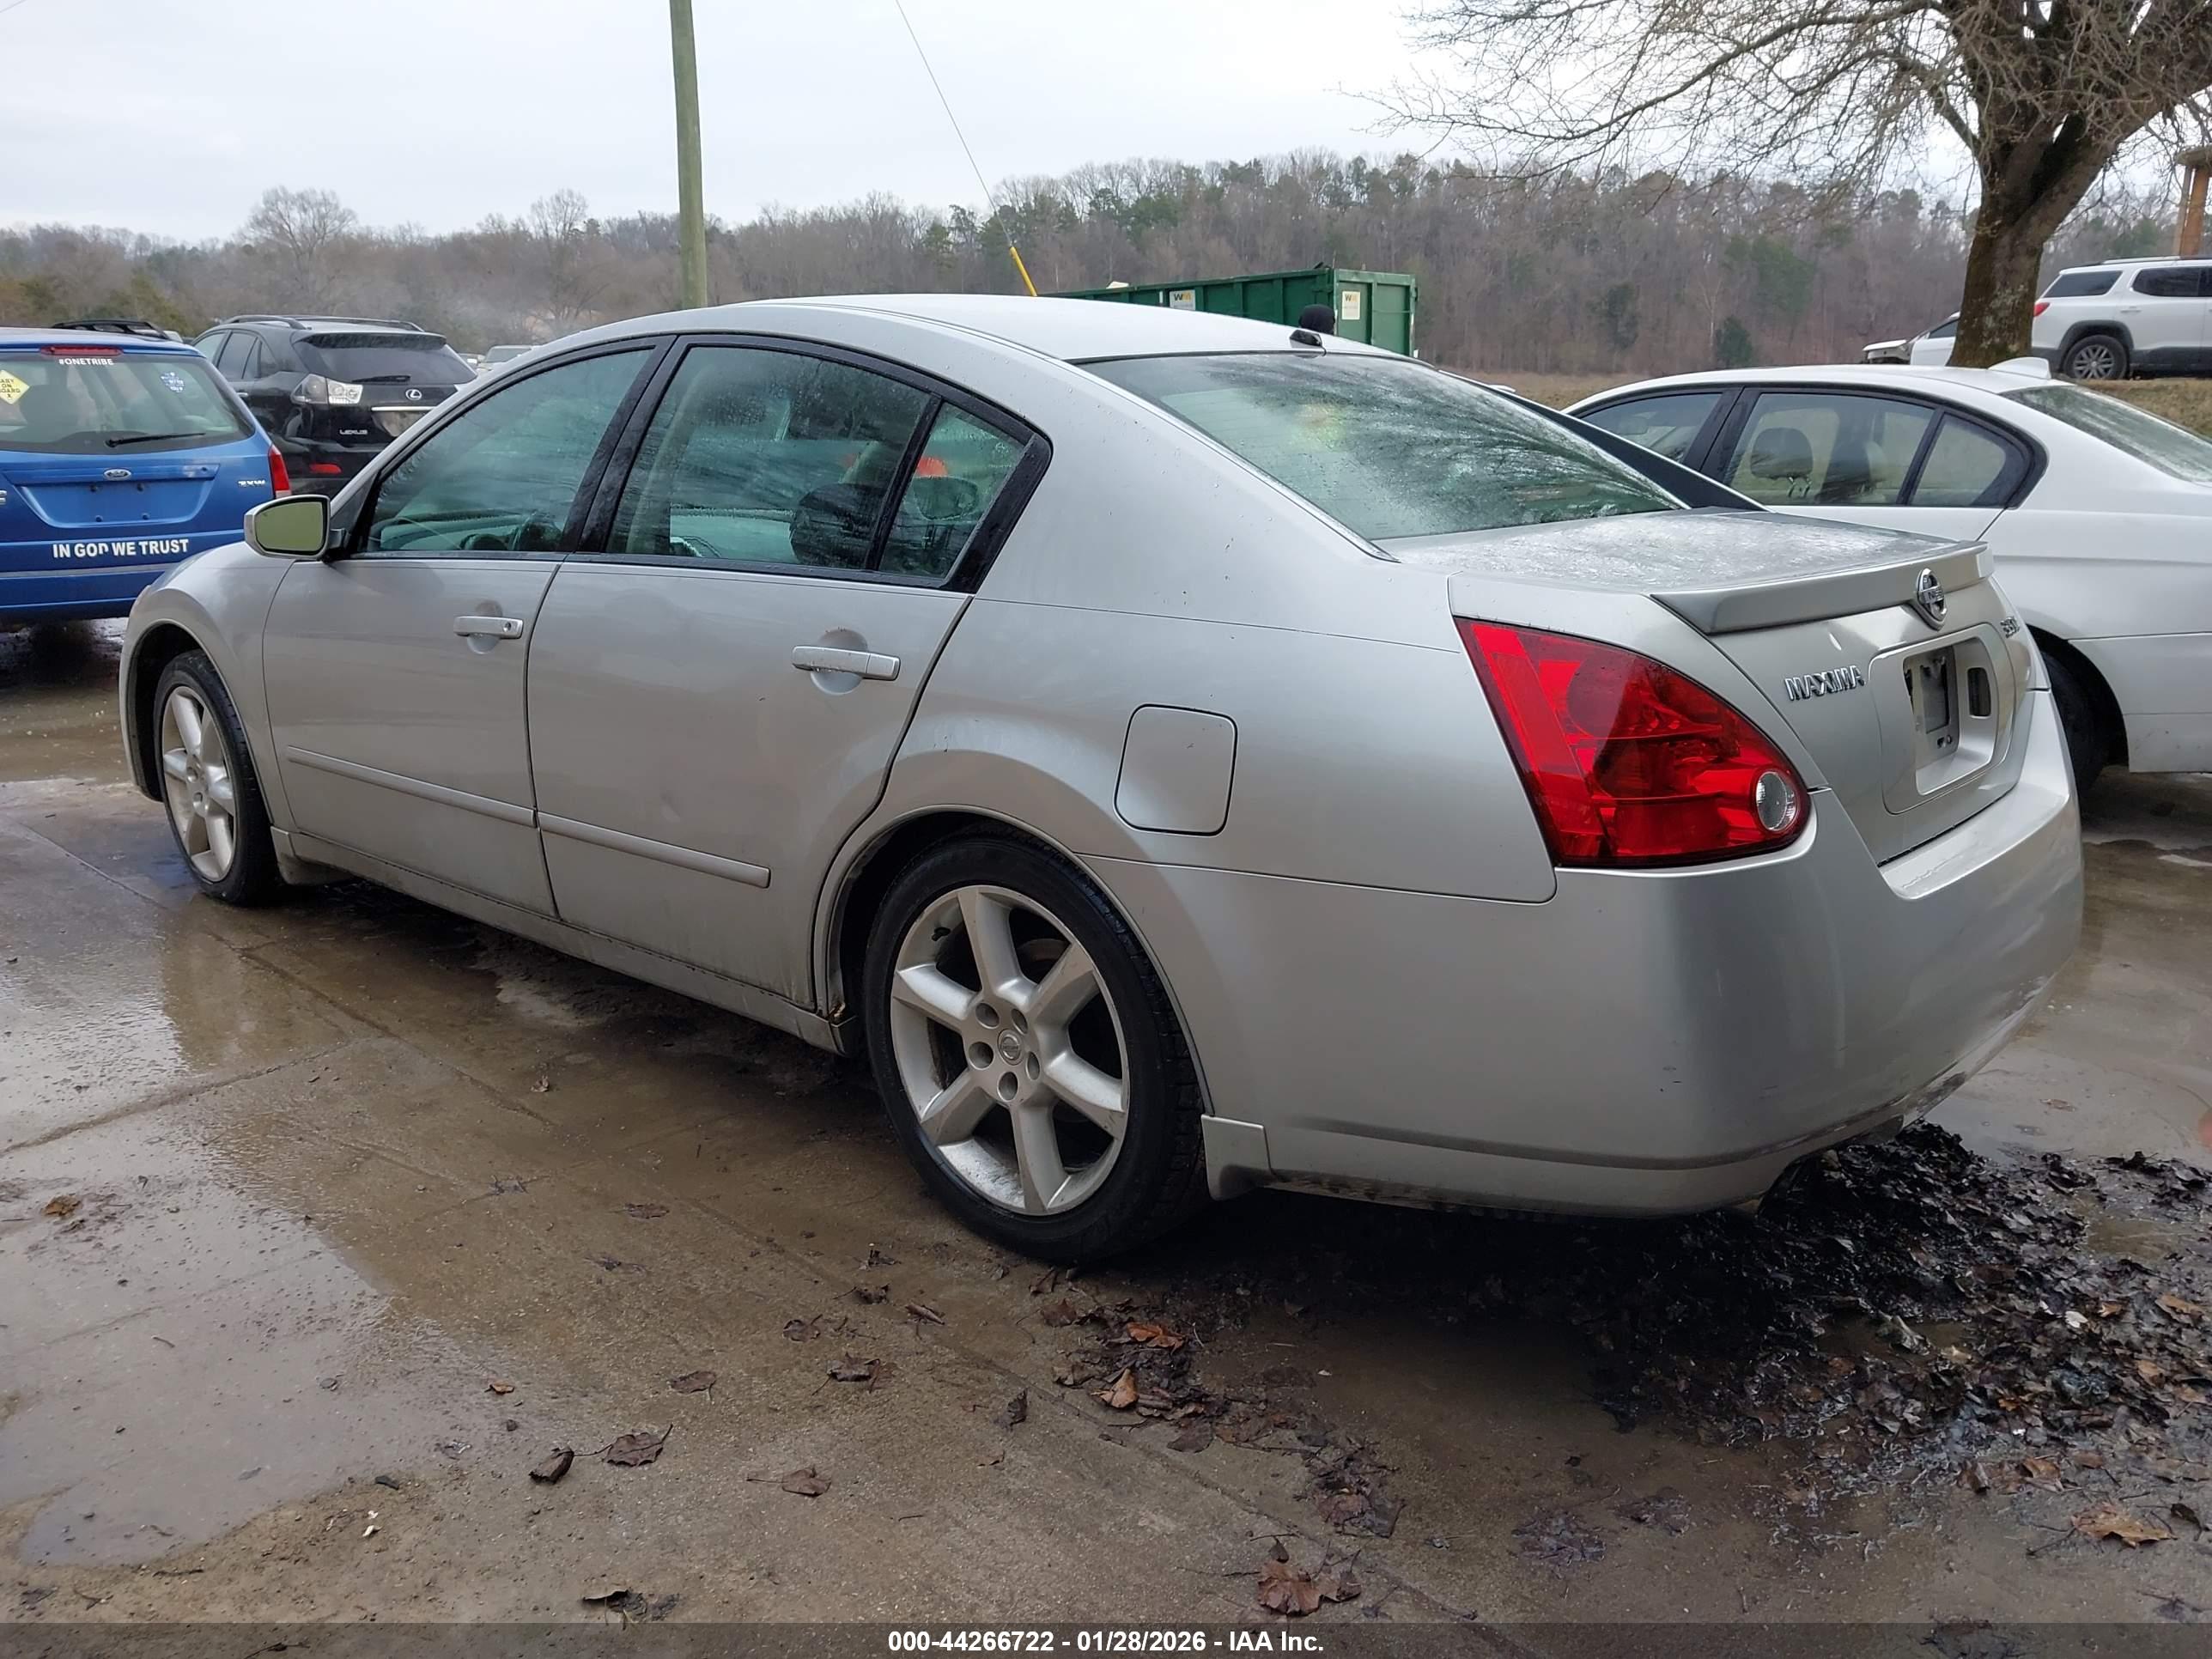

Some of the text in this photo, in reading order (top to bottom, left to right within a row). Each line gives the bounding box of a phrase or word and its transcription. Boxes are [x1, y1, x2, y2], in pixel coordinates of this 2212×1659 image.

[52, 538, 189, 558] IN GOD WE TRUST
[1784, 665, 1866, 702] MAXIMA
